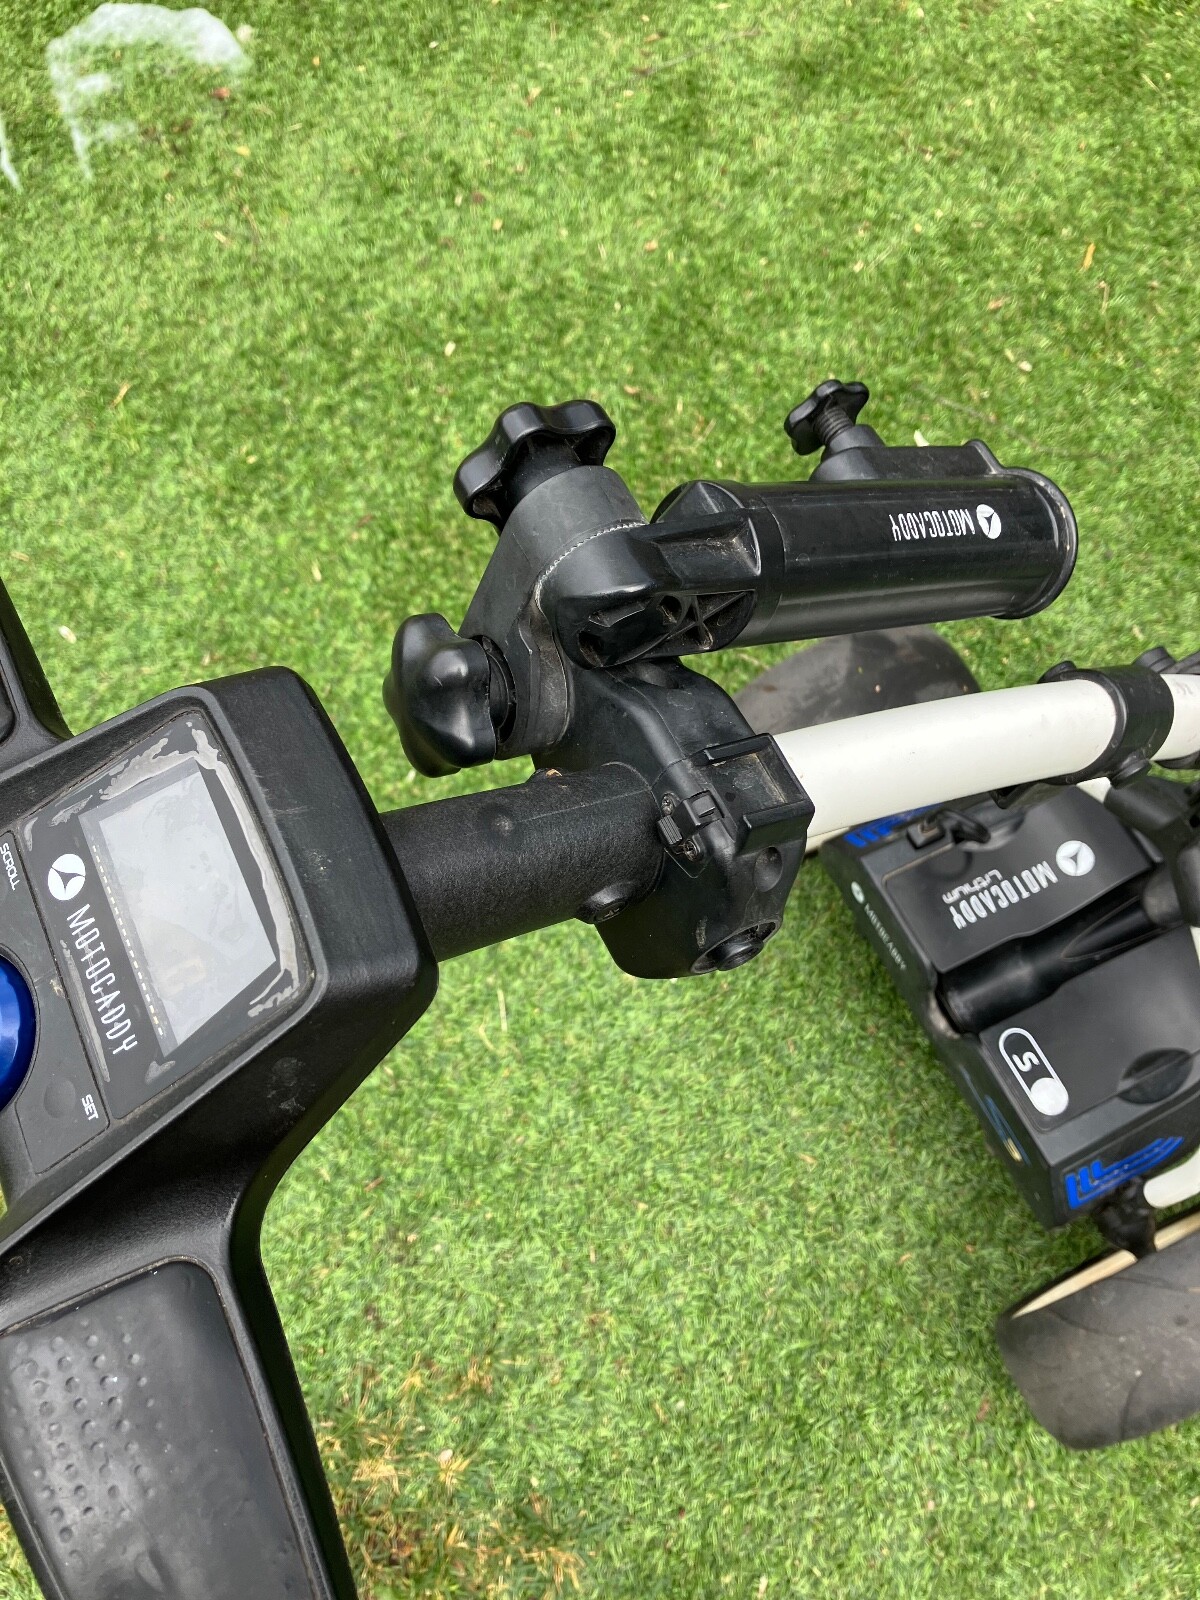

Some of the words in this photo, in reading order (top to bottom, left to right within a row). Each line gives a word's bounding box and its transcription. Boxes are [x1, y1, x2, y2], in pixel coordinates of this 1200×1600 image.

[889, 508, 976, 541] MOTOCADDY
[0, 843, 19, 891] SCROLL
[949, 861, 1058, 929] MOTOCADDY
[67, 903, 138, 1055] MOTOCADDY
[1012, 1051, 1040, 1072] S
[82, 1094, 99, 1121] SET
